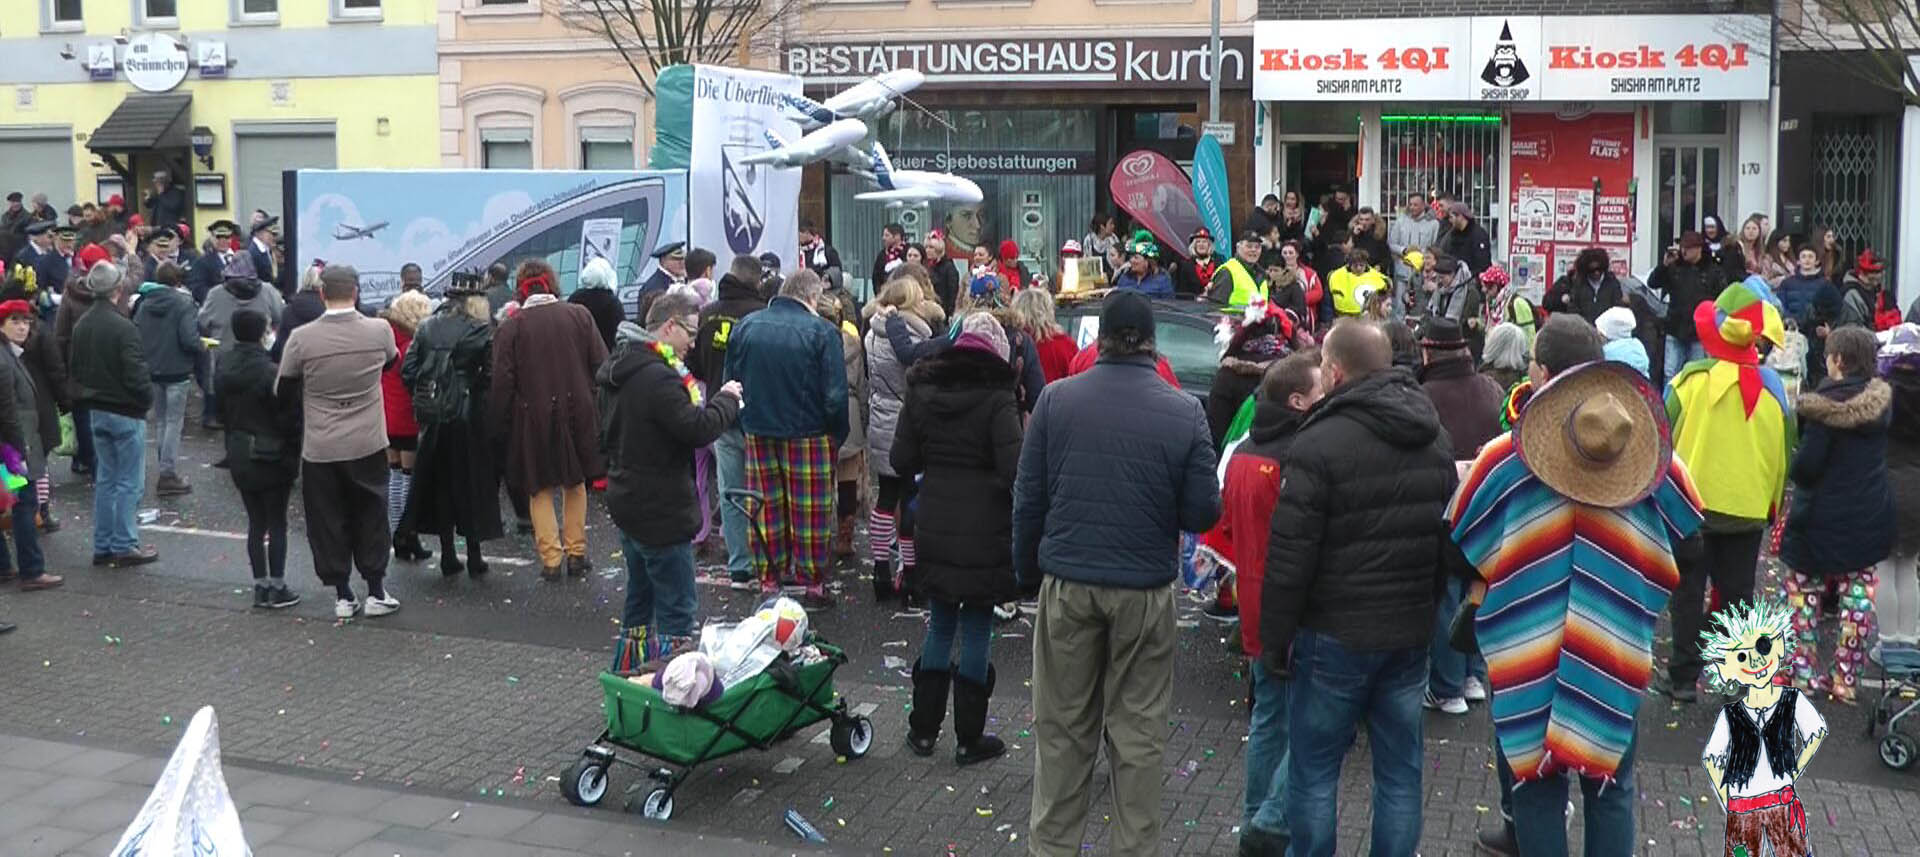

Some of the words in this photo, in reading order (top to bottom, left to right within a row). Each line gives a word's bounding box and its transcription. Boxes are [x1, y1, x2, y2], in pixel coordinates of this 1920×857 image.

[133, 43, 149, 54] am
[125, 57, 186, 72] Brünnchen
[788, 41, 1117, 75] BESTATTUNGSHAUS
[1124, 40, 1244, 82] kurth
[1259, 48, 1369, 71] Kiosk
[1377, 47, 1450, 74] 4QI
[1548, 45, 1666, 70] Kiosk
[1674, 43, 1749, 72] 4QI
[697, 77, 720, 100] Die
[723, 74, 790, 112] Überflieg
[1316, 79, 1350, 94] SHISHA
[1351, 79, 1368, 93] AM
[1369, 79, 1402, 93] PLATZ
[1481, 88, 1509, 99] SHISHA
[1510, 88, 1530, 100] SHOP
[1610, 78, 1647, 93] SHISHA
[1648, 78, 1666, 92] AM
[1666, 78, 1700, 93] PLATZ
[1589, 146, 1621, 159] FLATS
[889, 153, 1077, 173] euer-Seebestattungen
[1199, 188, 1228, 251] Hermes
